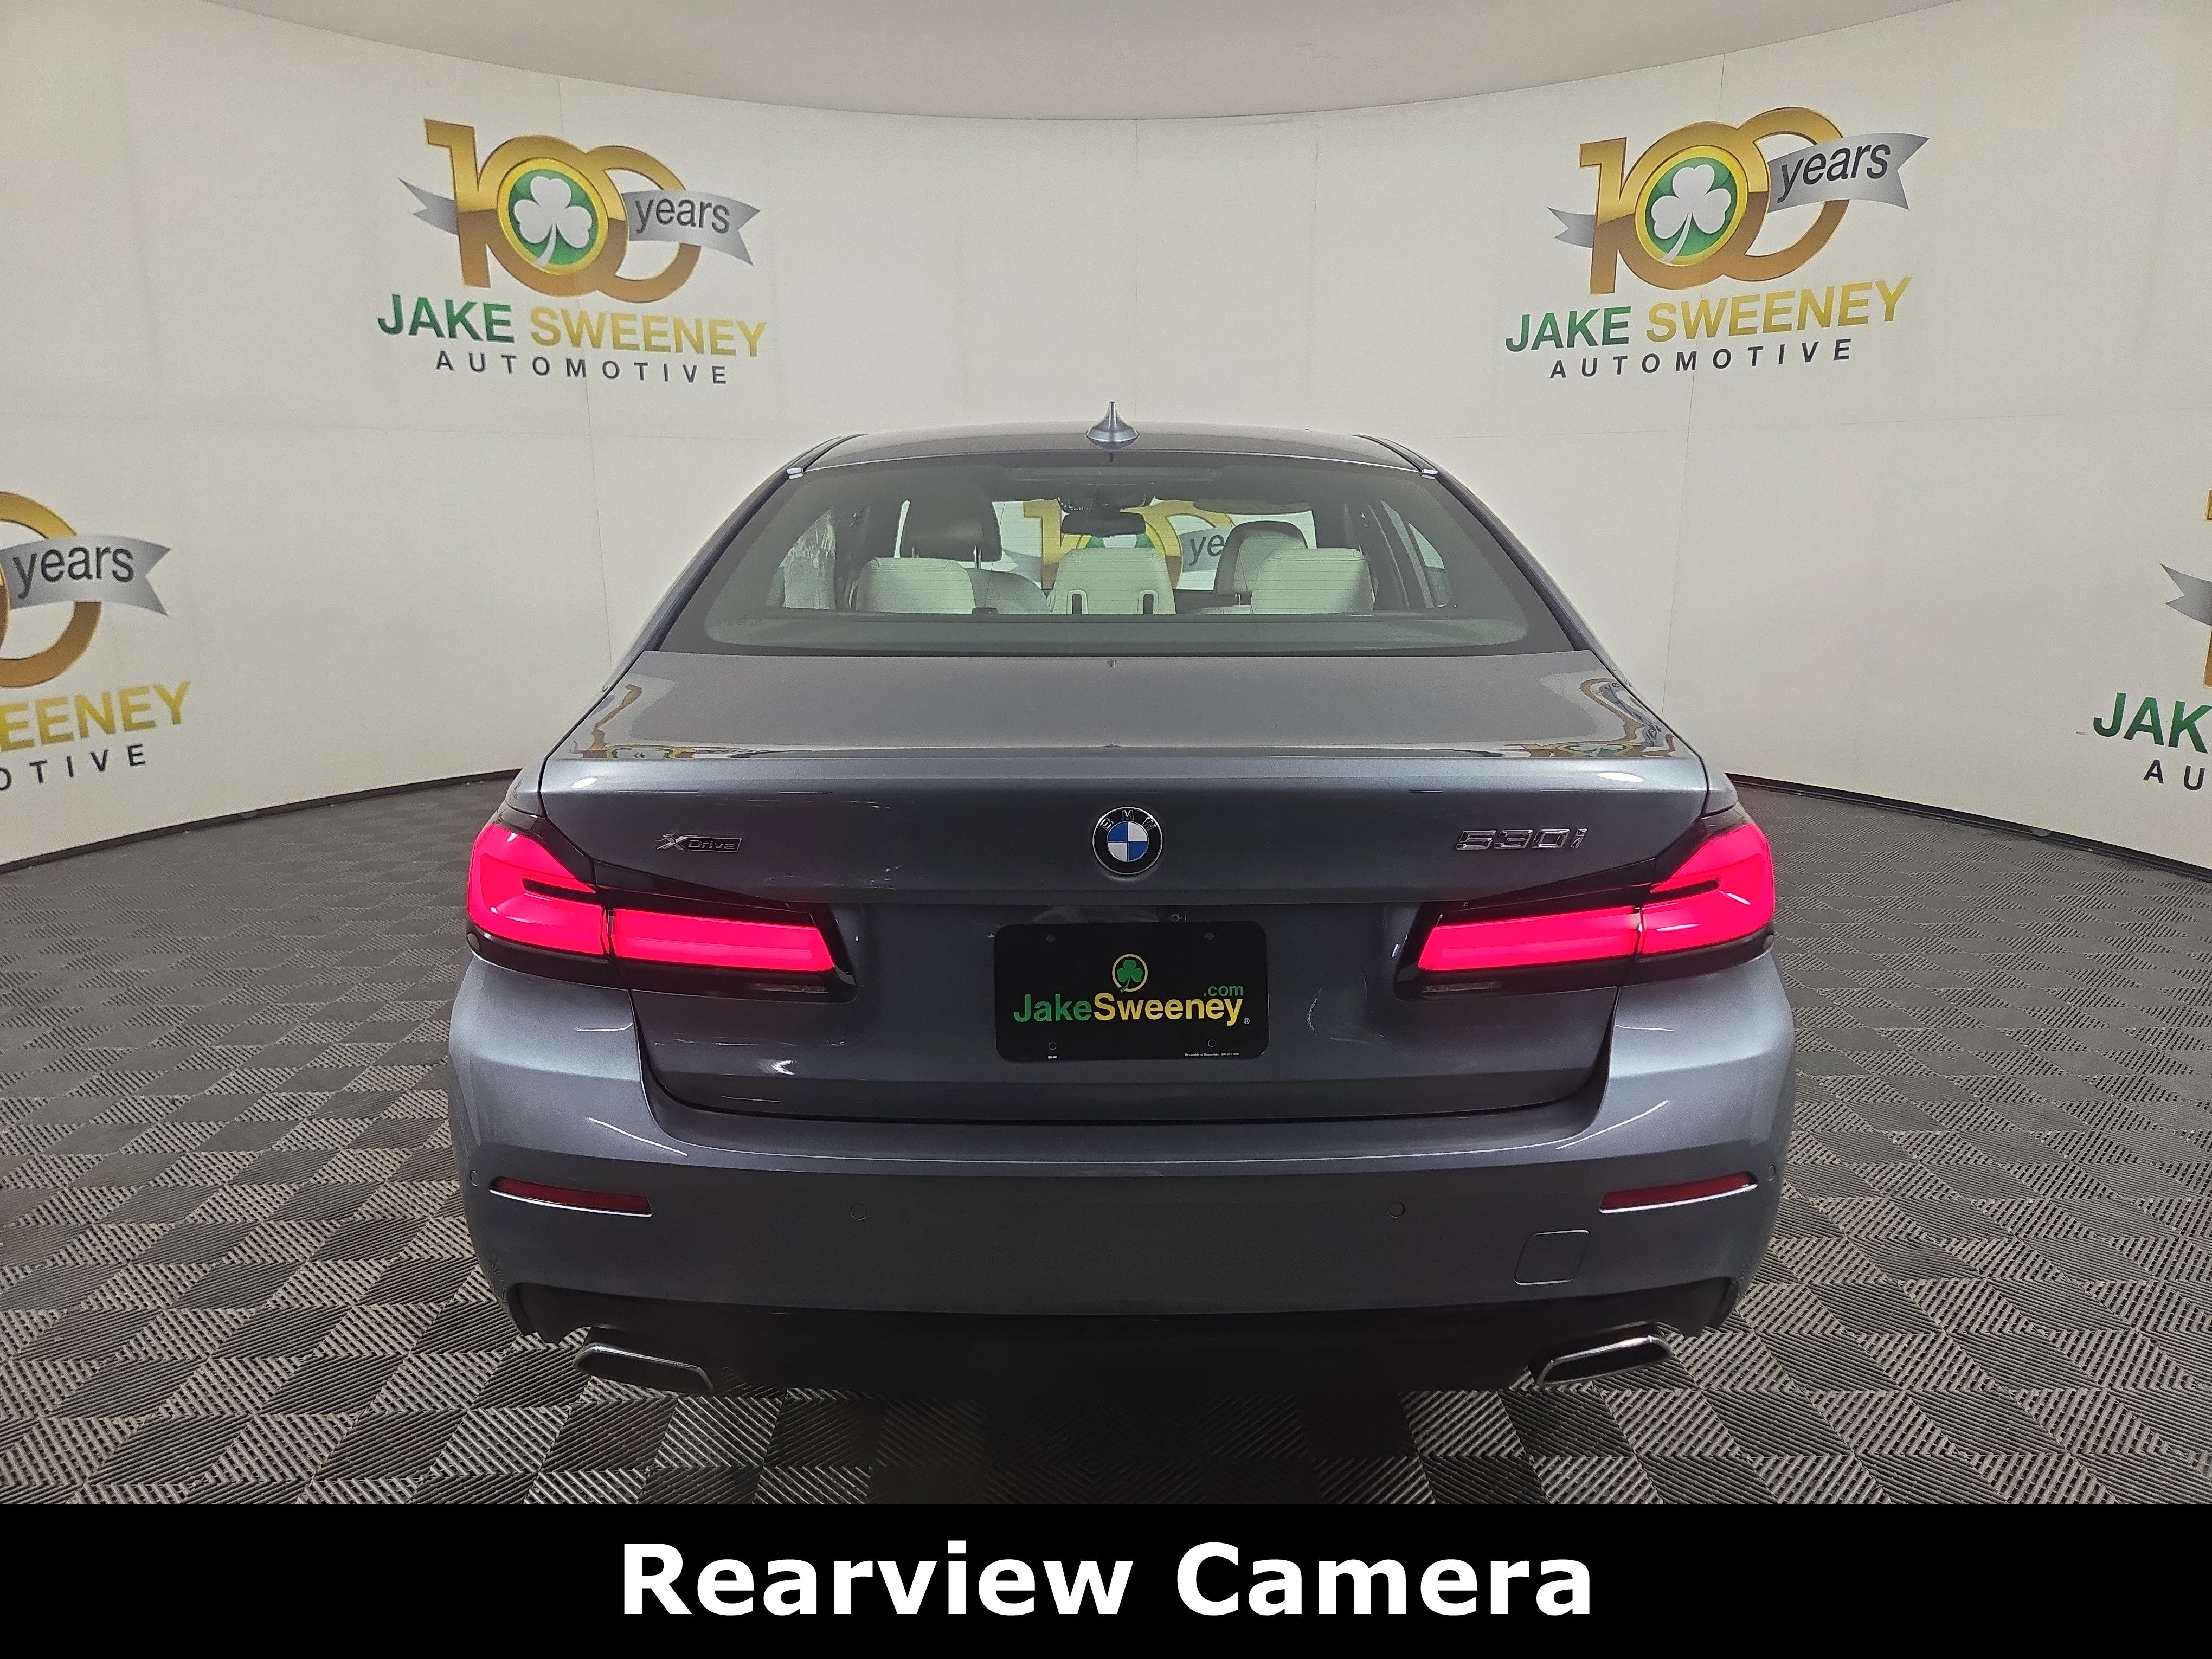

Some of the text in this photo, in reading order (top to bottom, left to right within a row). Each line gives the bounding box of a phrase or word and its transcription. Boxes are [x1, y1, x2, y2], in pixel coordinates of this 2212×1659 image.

[1776, 143, 1891, 203] years
[634, 197, 731, 234] years
[377, 294, 767, 358] JAKE SWEENEY
[1505, 276, 1913, 352] JAKE SWEENEY
[435, 350, 728, 385] AUTOMOTIVE
[1549, 337, 1851, 380] AUTOMOTIVE
[12, 545, 135, 599] years
[1099, 809, 1156, 832] BMW
[1456, 828, 1588, 850] 530i
[1203, 984, 1244, 997] .com
